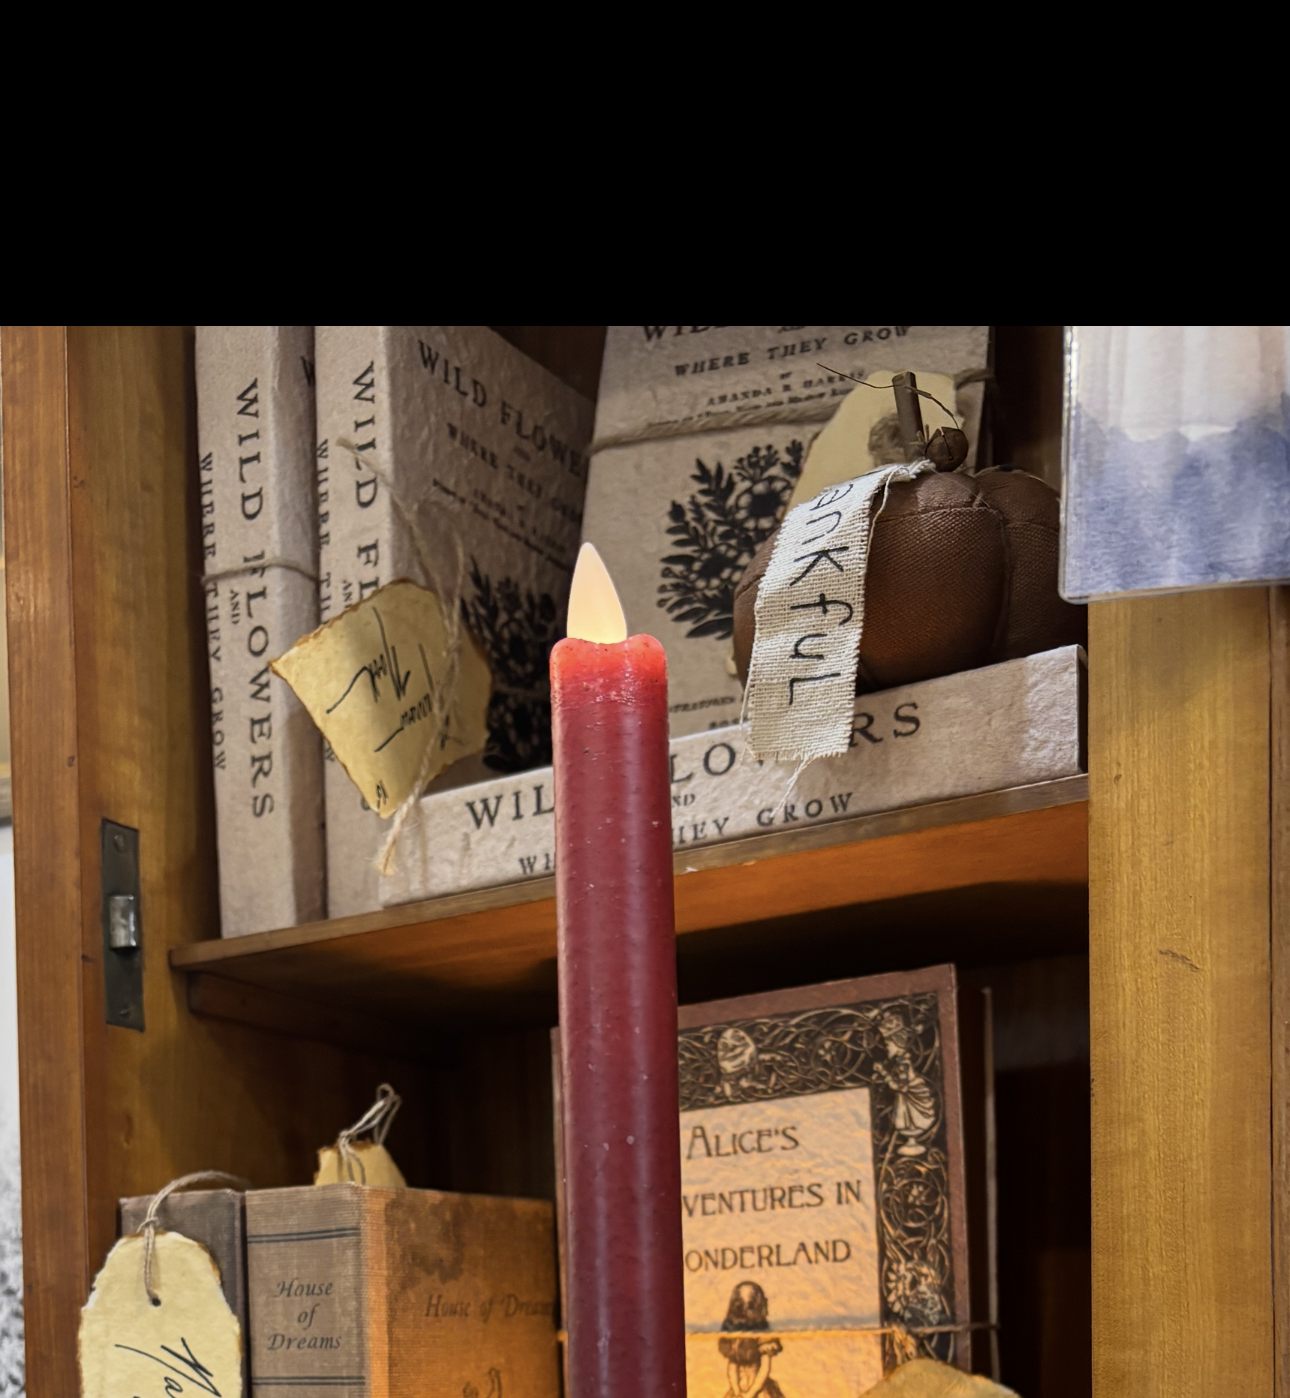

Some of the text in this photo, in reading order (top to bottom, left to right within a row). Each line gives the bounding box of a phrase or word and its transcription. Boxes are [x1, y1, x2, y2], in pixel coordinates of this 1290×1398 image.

[418, 339, 487, 408] WILD
[673, 352, 750, 377] WHERE
[767, 337, 828, 361] THEY
[352, 360, 378, 509] WILD
[200, 451, 226, 771] WHERE THEY GROW
[229, 589, 240, 625] AND
[236, 377, 274, 819] WILD FLOWERS
[465, 784, 555, 830] WIL
[671, 793, 696, 808] ND
[671, 792, 854, 845] HEY GROW
[686, 1125, 800, 1160] ALICE'S
[683, 1179, 862, 1218] VENTURES IN
[685, 1239, 851, 1272] ONDERLAND
[276, 1277, 334, 1299] House
[297, 1303, 321, 1331] of
[425, 1293, 470, 1318] House
[480, 1296, 497, 1324] of
[267, 1333, 342, 1351] Dreams
